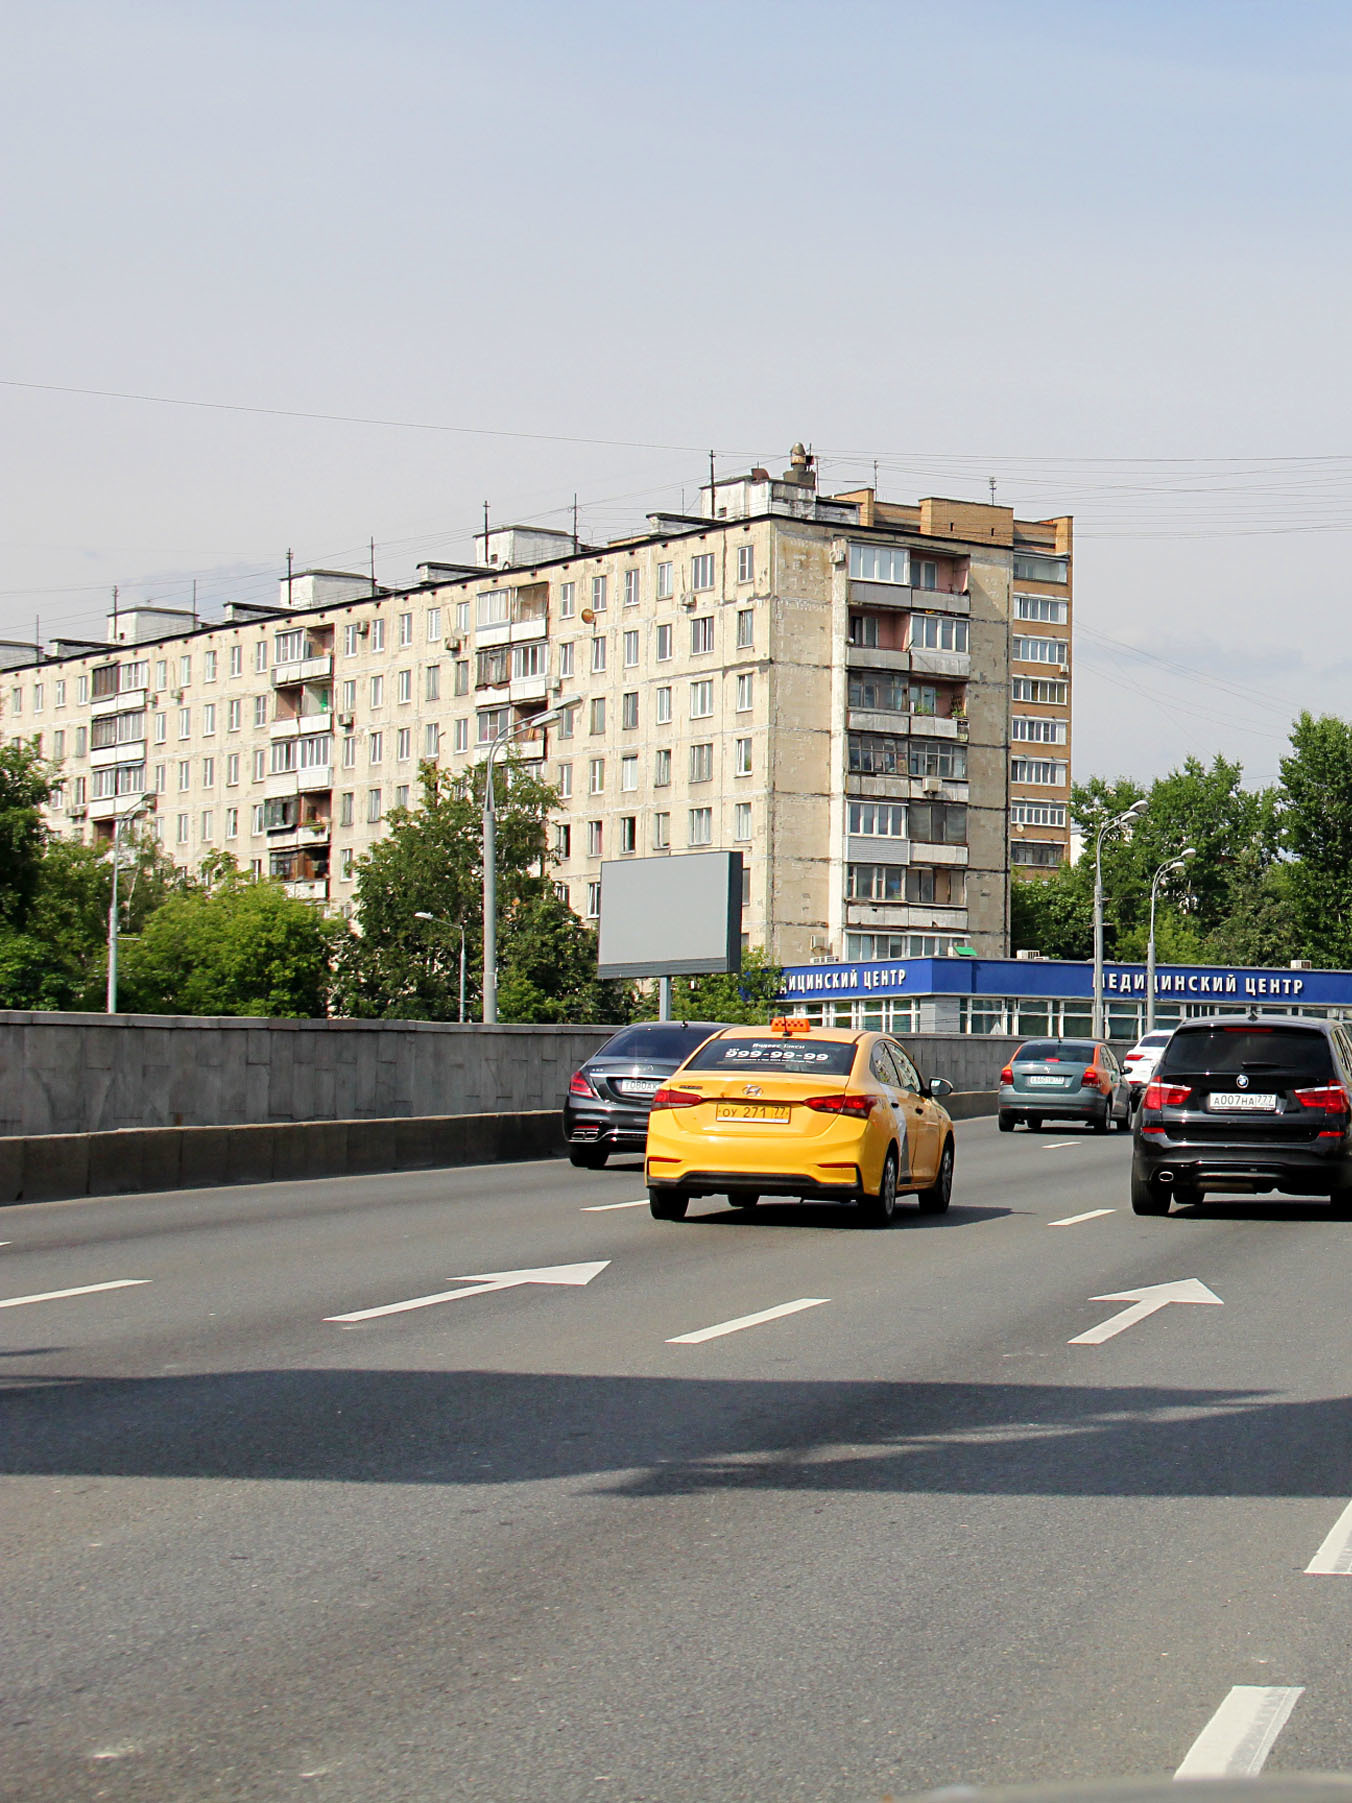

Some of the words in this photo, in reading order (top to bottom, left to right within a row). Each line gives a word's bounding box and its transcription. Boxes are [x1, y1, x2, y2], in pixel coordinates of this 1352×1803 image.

[780, 969, 858, 994] ДИЦИНСКИЙ
[863, 968, 907, 990] ЦЕНТР
[1245, 977, 1304, 995] ЦЕНТР
[725, 1050, 829, 1061] 999-99-99
[743, 1106, 766, 1119] 271
[774, 1106, 786, 1117] 77
